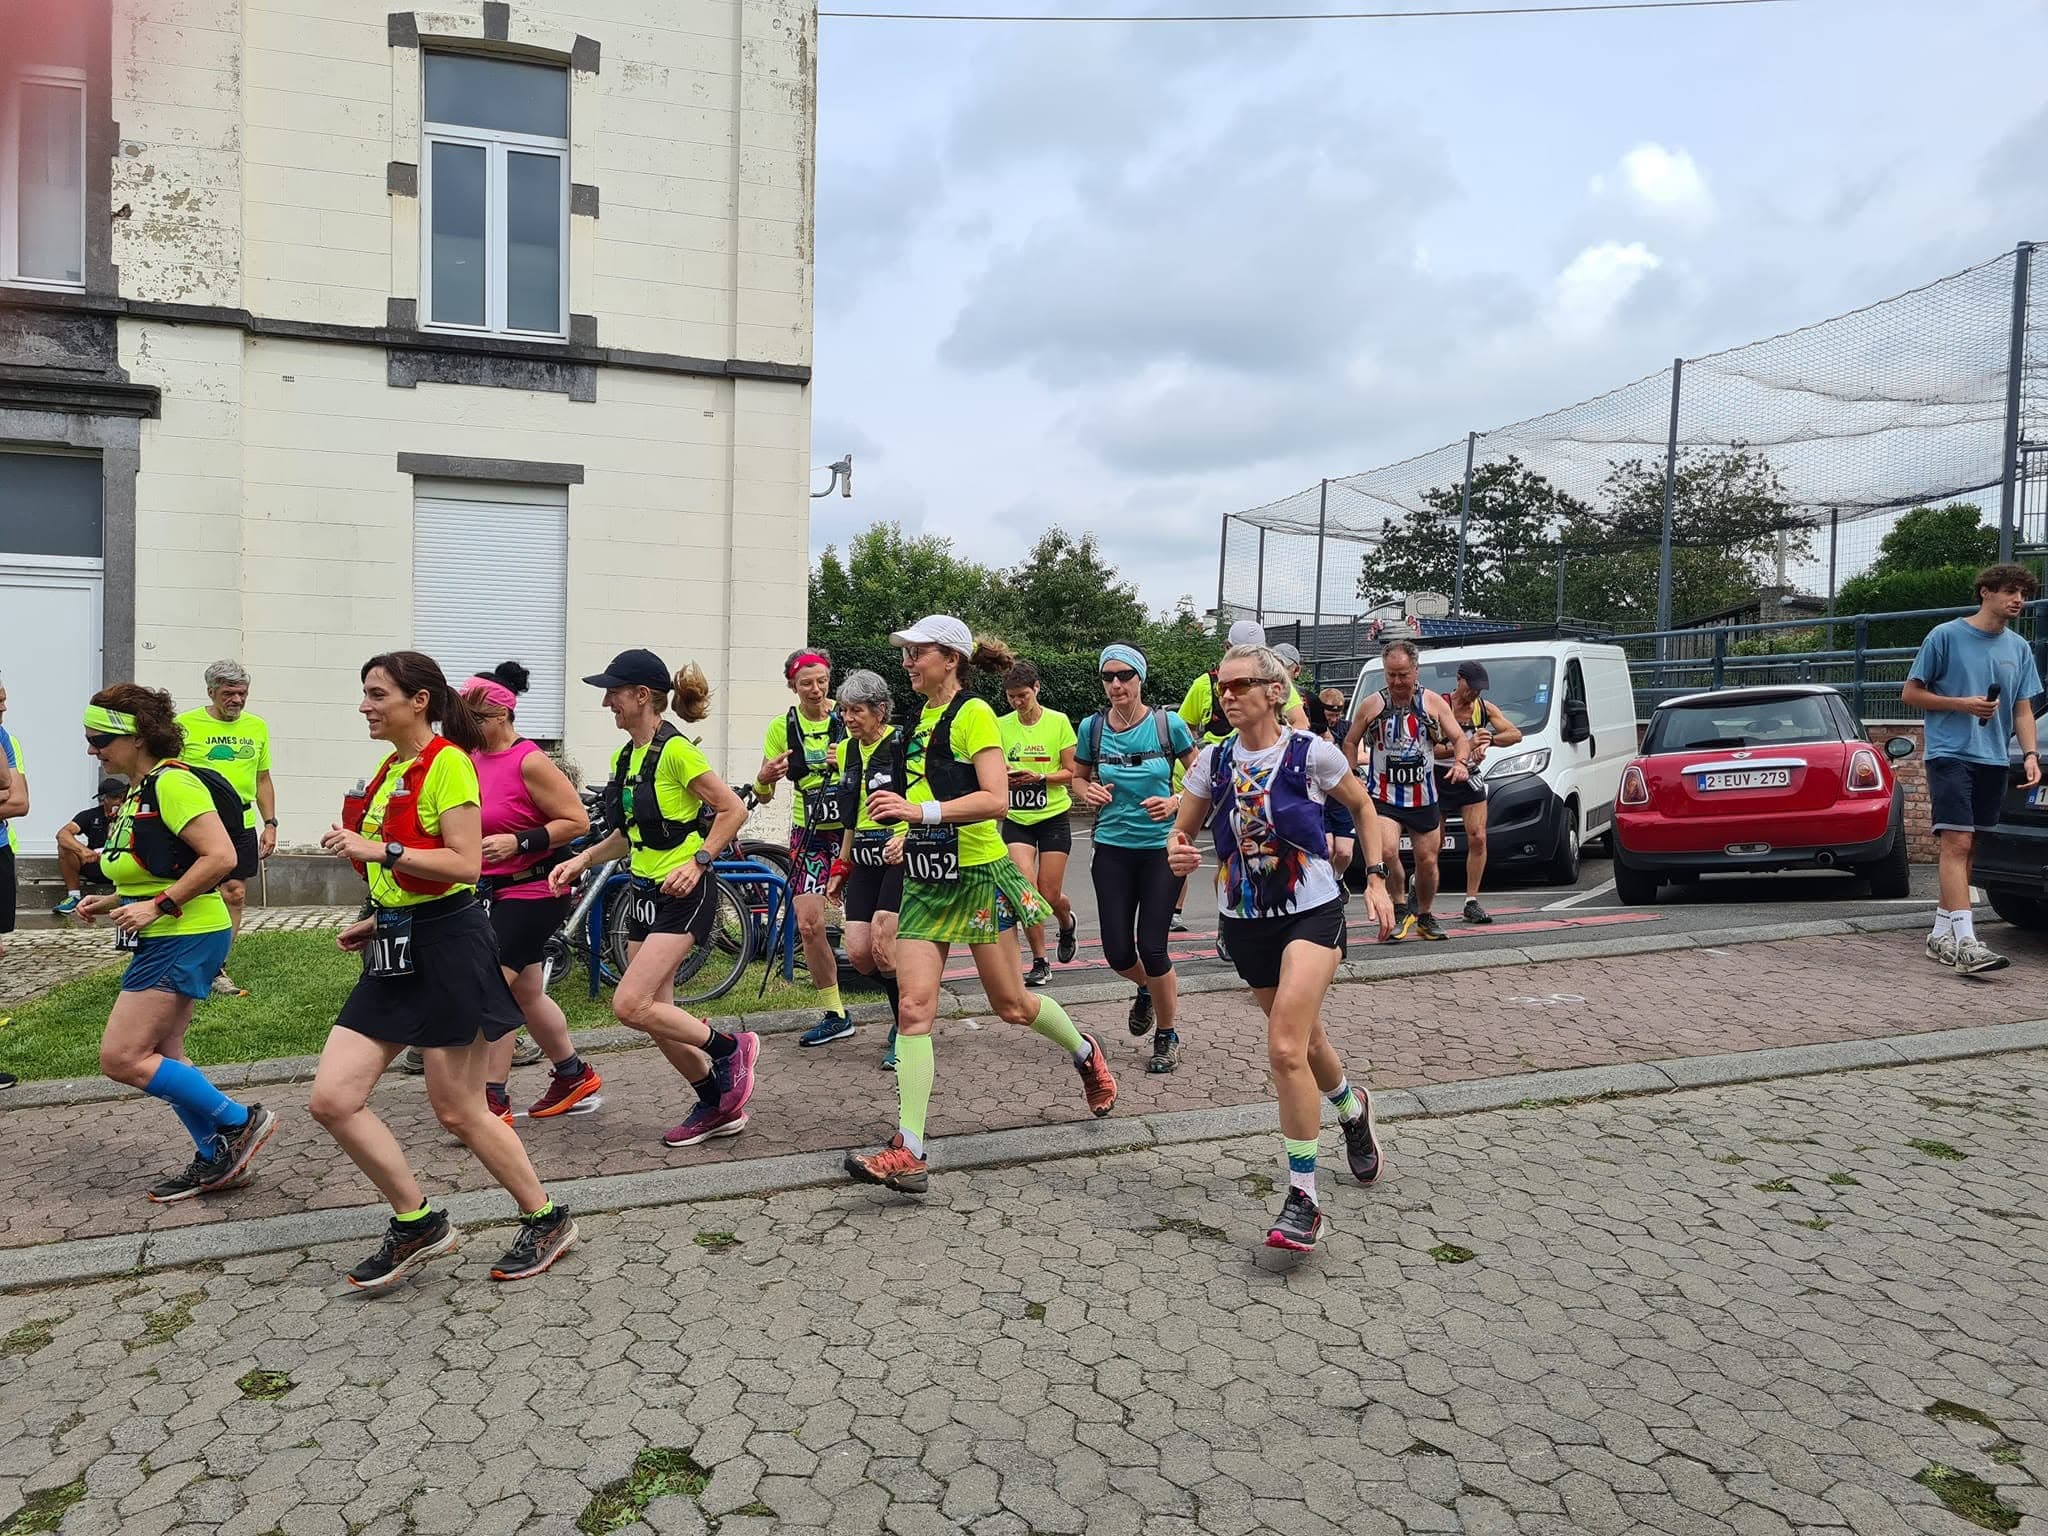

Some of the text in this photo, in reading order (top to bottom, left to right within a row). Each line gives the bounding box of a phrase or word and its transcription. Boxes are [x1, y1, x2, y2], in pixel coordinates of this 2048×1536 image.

[205, 736, 254, 746] JAMES club
[1388, 766, 1424, 784] 1018
[1008, 790, 1047, 808] 1026
[905, 852, 958, 880] 1052
